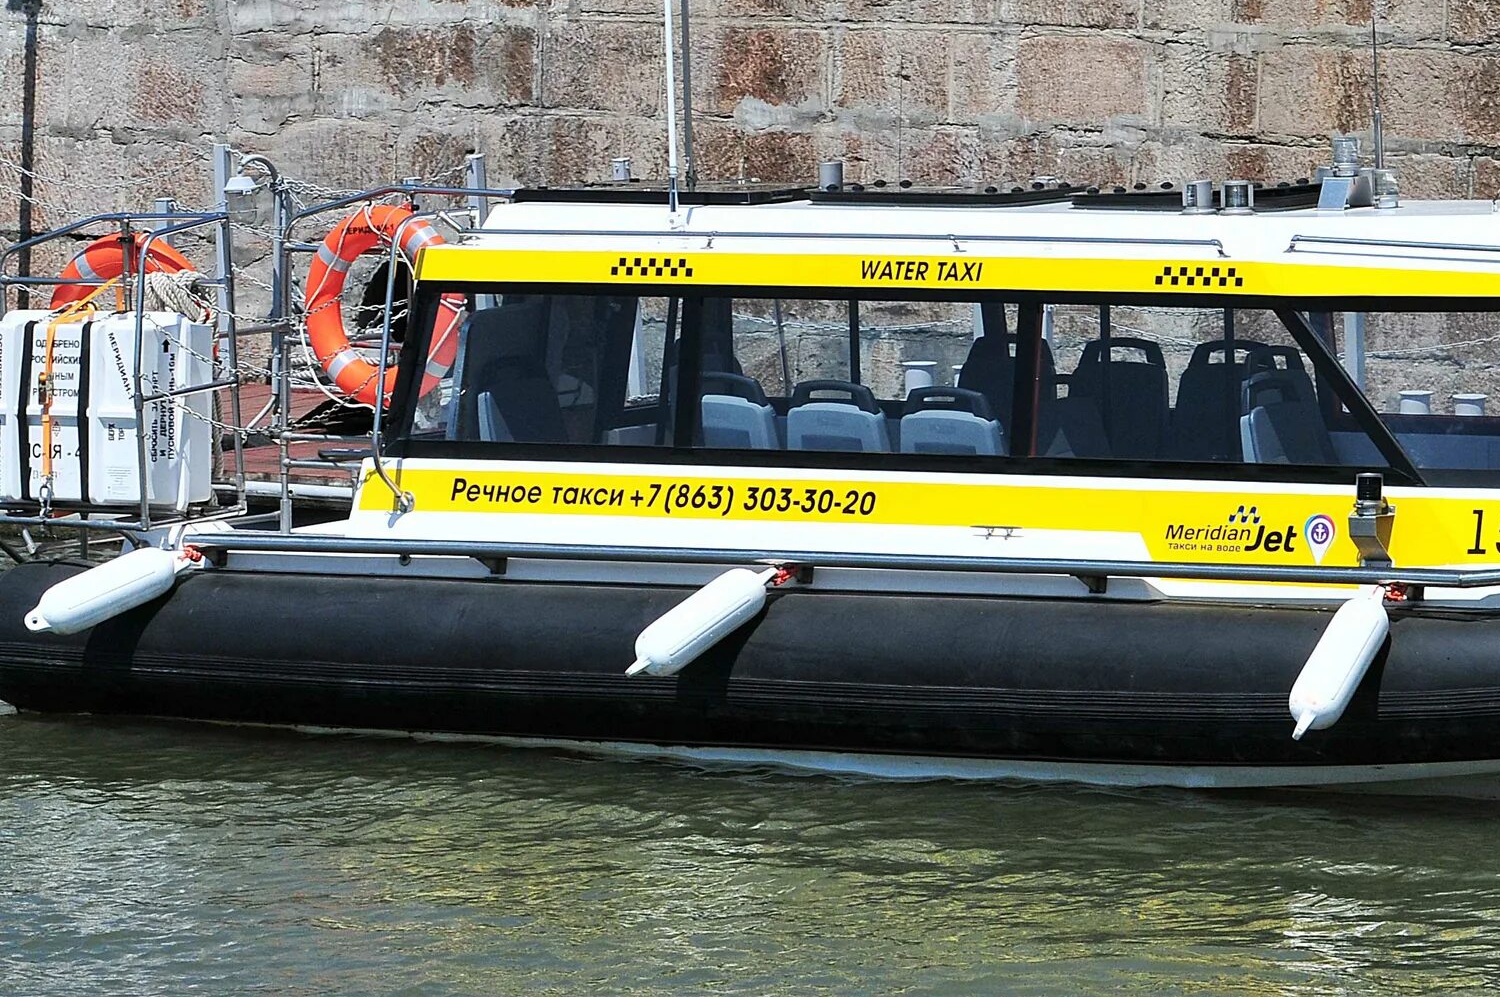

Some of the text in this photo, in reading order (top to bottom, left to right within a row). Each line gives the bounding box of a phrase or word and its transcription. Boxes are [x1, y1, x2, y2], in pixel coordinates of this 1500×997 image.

[861, 260, 983, 282] WATER TAXI
[451, 477, 542, 504] Речное
[552, 486, 625, 507] такси
[743, 486, 876, 516] 303-30-20
[1168, 542, 1197, 551] такси
[1217, 545, 1241, 553] воде
